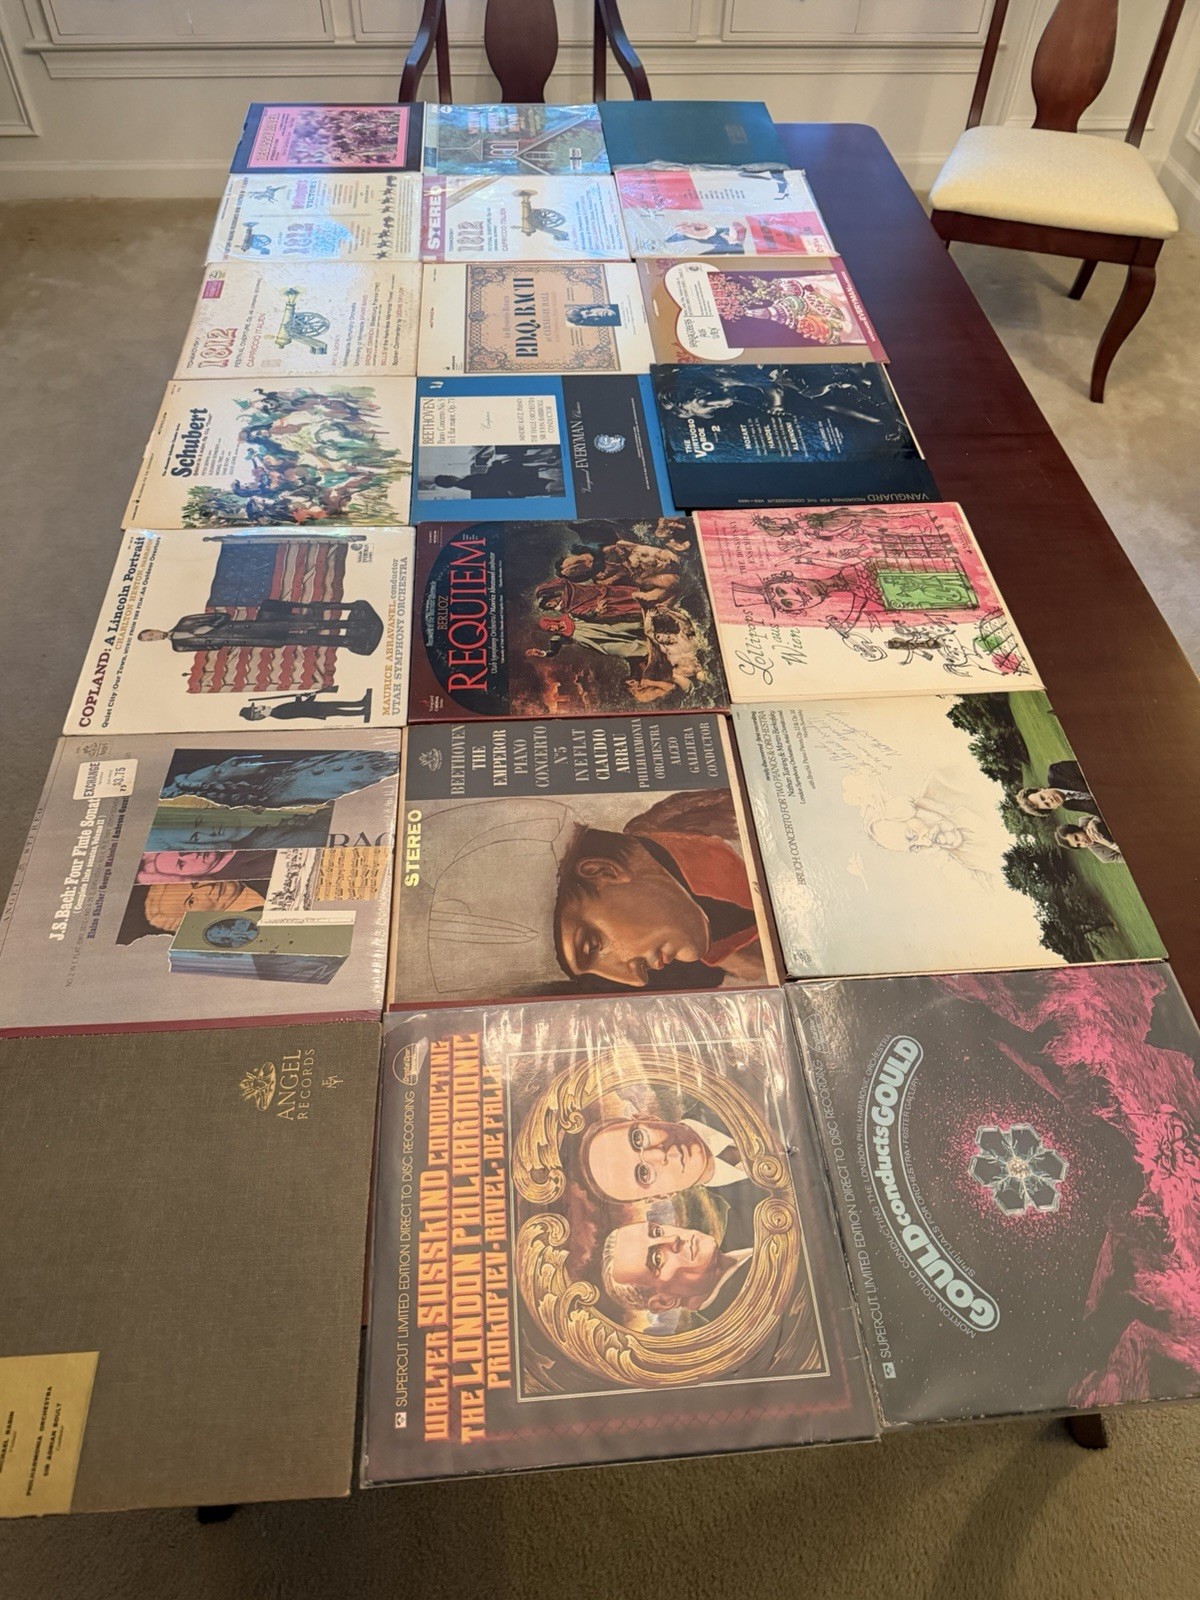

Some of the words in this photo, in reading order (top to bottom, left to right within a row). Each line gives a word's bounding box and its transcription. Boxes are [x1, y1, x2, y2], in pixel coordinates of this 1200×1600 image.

[427, 185, 441, 249] STEREO
[457, 221, 485, 251] 1812
[513, 278, 536, 316] BACH
[846, 287, 867, 321] EVERYMAN
[198, 328, 238, 368] 1812
[247, 335, 261, 368] CAPRICCIO
[255, 313, 266, 334] ITALIEN
[515, 319, 541, 358] P.D.Q.
[422, 399, 435, 445] BEETHOVEN
[687, 418, 707, 459] VIRTUOSO
[697, 427, 715, 452] OBOE
[740, 424, 752, 450] MOZART
[764, 424, 776, 449] HANDEL
[786, 422, 800, 451] ALBINONI
[170, 408, 208, 478] Schubert
[570, 421, 589, 468] EVERYMAN
[683, 439, 693, 454] THE
[867, 492, 930, 502] VANGUARD
[122, 536, 145, 582] Portrait
[397, 557, 408, 616] ORCHESTRA
[107, 585, 131, 632] Lincoln
[437, 595, 449, 630] BERLIOZ
[447, 537, 488, 693] REQUIEM
[104, 635, 116, 646] A
[382, 665, 393, 717] MAURICE
[389, 559, 399, 600] conductor
[393, 614, 405, 680] SYMPHONY
[734, 609, 774, 686] Lollipops
[770, 623, 783, 643] aus
[771, 628, 808, 666] Wien
[78, 648, 112, 728] COPLAND:
[392, 683, 402, 716] UTAH
[101, 708, 113, 728] Quiet
[107, 692, 118, 707] City
[758, 711, 774, 750] ORCHESTRA
[450, 725, 467, 795] BEETHOVEN
[472, 745, 487, 771] THE
[492, 728, 508, 787] EMPEROR
[512, 738, 529, 775] PIANO
[532, 726, 550, 788] CONCERTO
[572, 728, 588, 757] FLAT
[574, 758, 589, 767] E
[592, 728, 611, 781] CLAUDIO
[613, 733, 631, 774] ARRAU
[631, 718, 651, 788] PHILHARMONIA
[649, 724, 667, 779] ORCHESTRA
[668, 736, 683, 766] ALCEO
[683, 727, 701, 774] GALLIERA
[698, 722, 719, 777] CONDUCTOR
[775, 735, 784, 751] Martin
[83, 762, 100, 797] EXCHANGE
[112, 767, 126, 787] $3.75
[574, 768, 591, 782] IN
[767, 756, 781, 782] PIANOS
[785, 777, 796, 797] Nathan
[773, 782, 786, 799] TWO
[778, 799, 789, 813] FOR
[71, 830, 92, 857] Flute
[404, 809, 422, 887] STEREO
[781, 813, 799, 856] CONCERTO
[63, 858, 85, 885] Four
[866, 1034, 892, 1076] ORCHESTRA
[276, 1049, 302, 1121] ANGEL
[297, 1048, 316, 1121] RECORDS
[427, 1039, 450, 1166] CONDUCTING
[482, 1063, 505, 1129] FALLA
[814, 1059, 836, 1119] RECORDING
[871, 1039, 919, 1127] GOULD
[902, 1075, 919, 1111] GALLERY
[402, 1091, 416, 1154] RECORDING
[856, 1076, 870, 1142] PHILHARMONIC
[901, 1111, 910, 1144] FOSTER
[451, 1032, 481, 1247] PHILHARMONIC
[482, 1132, 505, 1160] DE
[828, 1120, 842, 1146] DISC
[401, 1156, 414, 1182] DISC
[833, 1147, 845, 1162] TO
[857, 1143, 870, 1183] LONDON
[400, 1184, 413, 1200] TO
[839, 1165, 857, 1202] DIRECT
[863, 1185, 876, 1204] THE
[873, 1125, 911, 1226] conducts
[902, 1149, 925, 1206] ORCHESTRA
[399, 1202, 413, 1241] DIRECT
[482, 1167, 507, 1242] RAVEL
[921, 1206, 936, 1224] FOR
[847, 1204, 866, 1248] EDITION
[872, 1206, 910, 1269] CONDUCTING
[398, 1243, 412, 1289] EDITION
[857, 1250, 877, 1293] LIMITED
[933, 1225, 976, 1277] SPIRITUALS
[902, 1224, 995, 1326] GOULD
[909, 1270, 938, 1302] GOULD
[396, 1293, 410, 1339] LIMITED
[451, 1251, 483, 1387] LONDON
[868, 1295, 892, 1358] SUPERCUT
[936, 1302, 976, 1339] MORTON
[395, 1342, 409, 1407] SUPERCUT
[424, 1329, 450, 1441] WALTER
[38, 1386, 53, 1432] ORCHESTRA
[461, 1388, 486, 1444] THE
